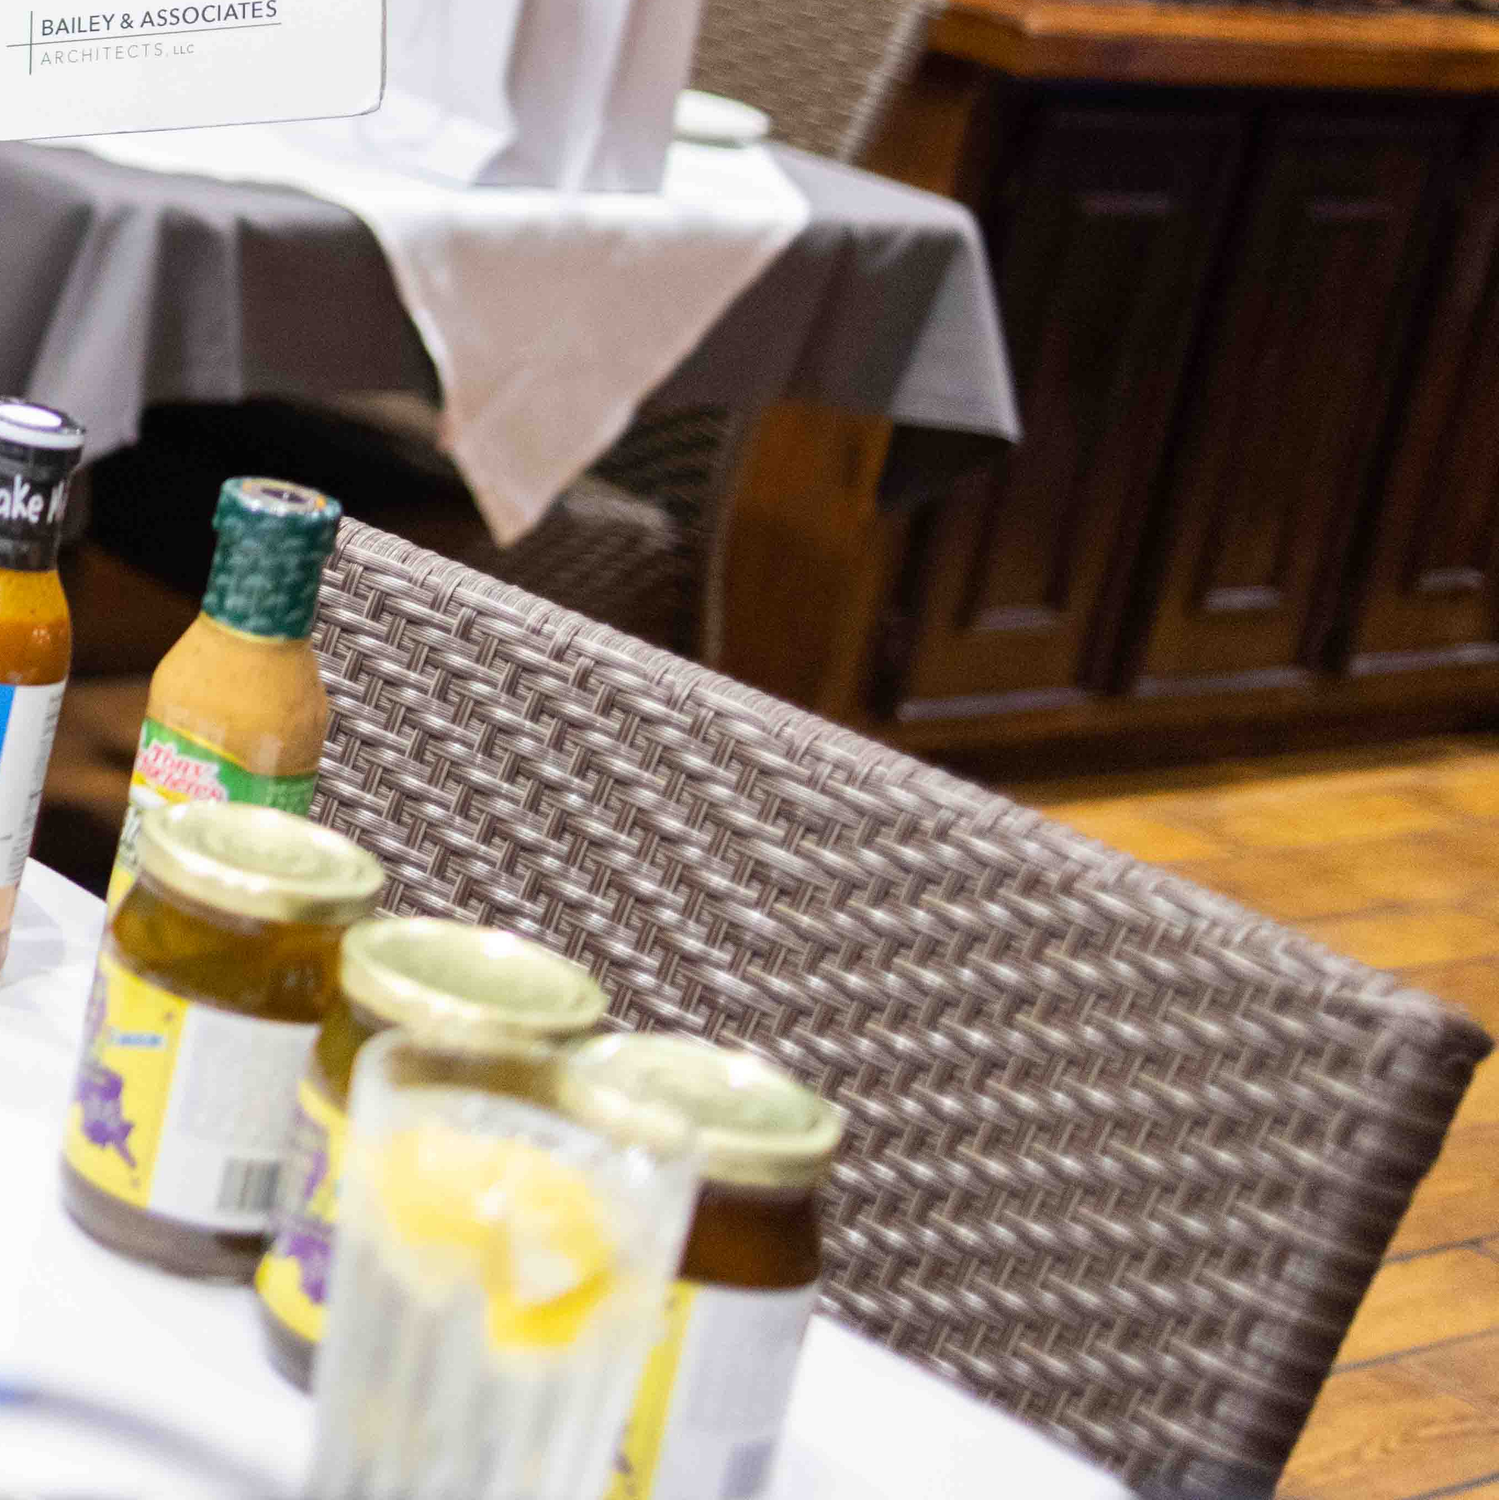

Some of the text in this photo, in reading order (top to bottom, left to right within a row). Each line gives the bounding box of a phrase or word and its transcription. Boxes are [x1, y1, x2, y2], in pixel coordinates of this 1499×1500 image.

[41, 0, 278, 36] BAILEY & ASSOCIATES
[172, 43, 195, 56] LLC
